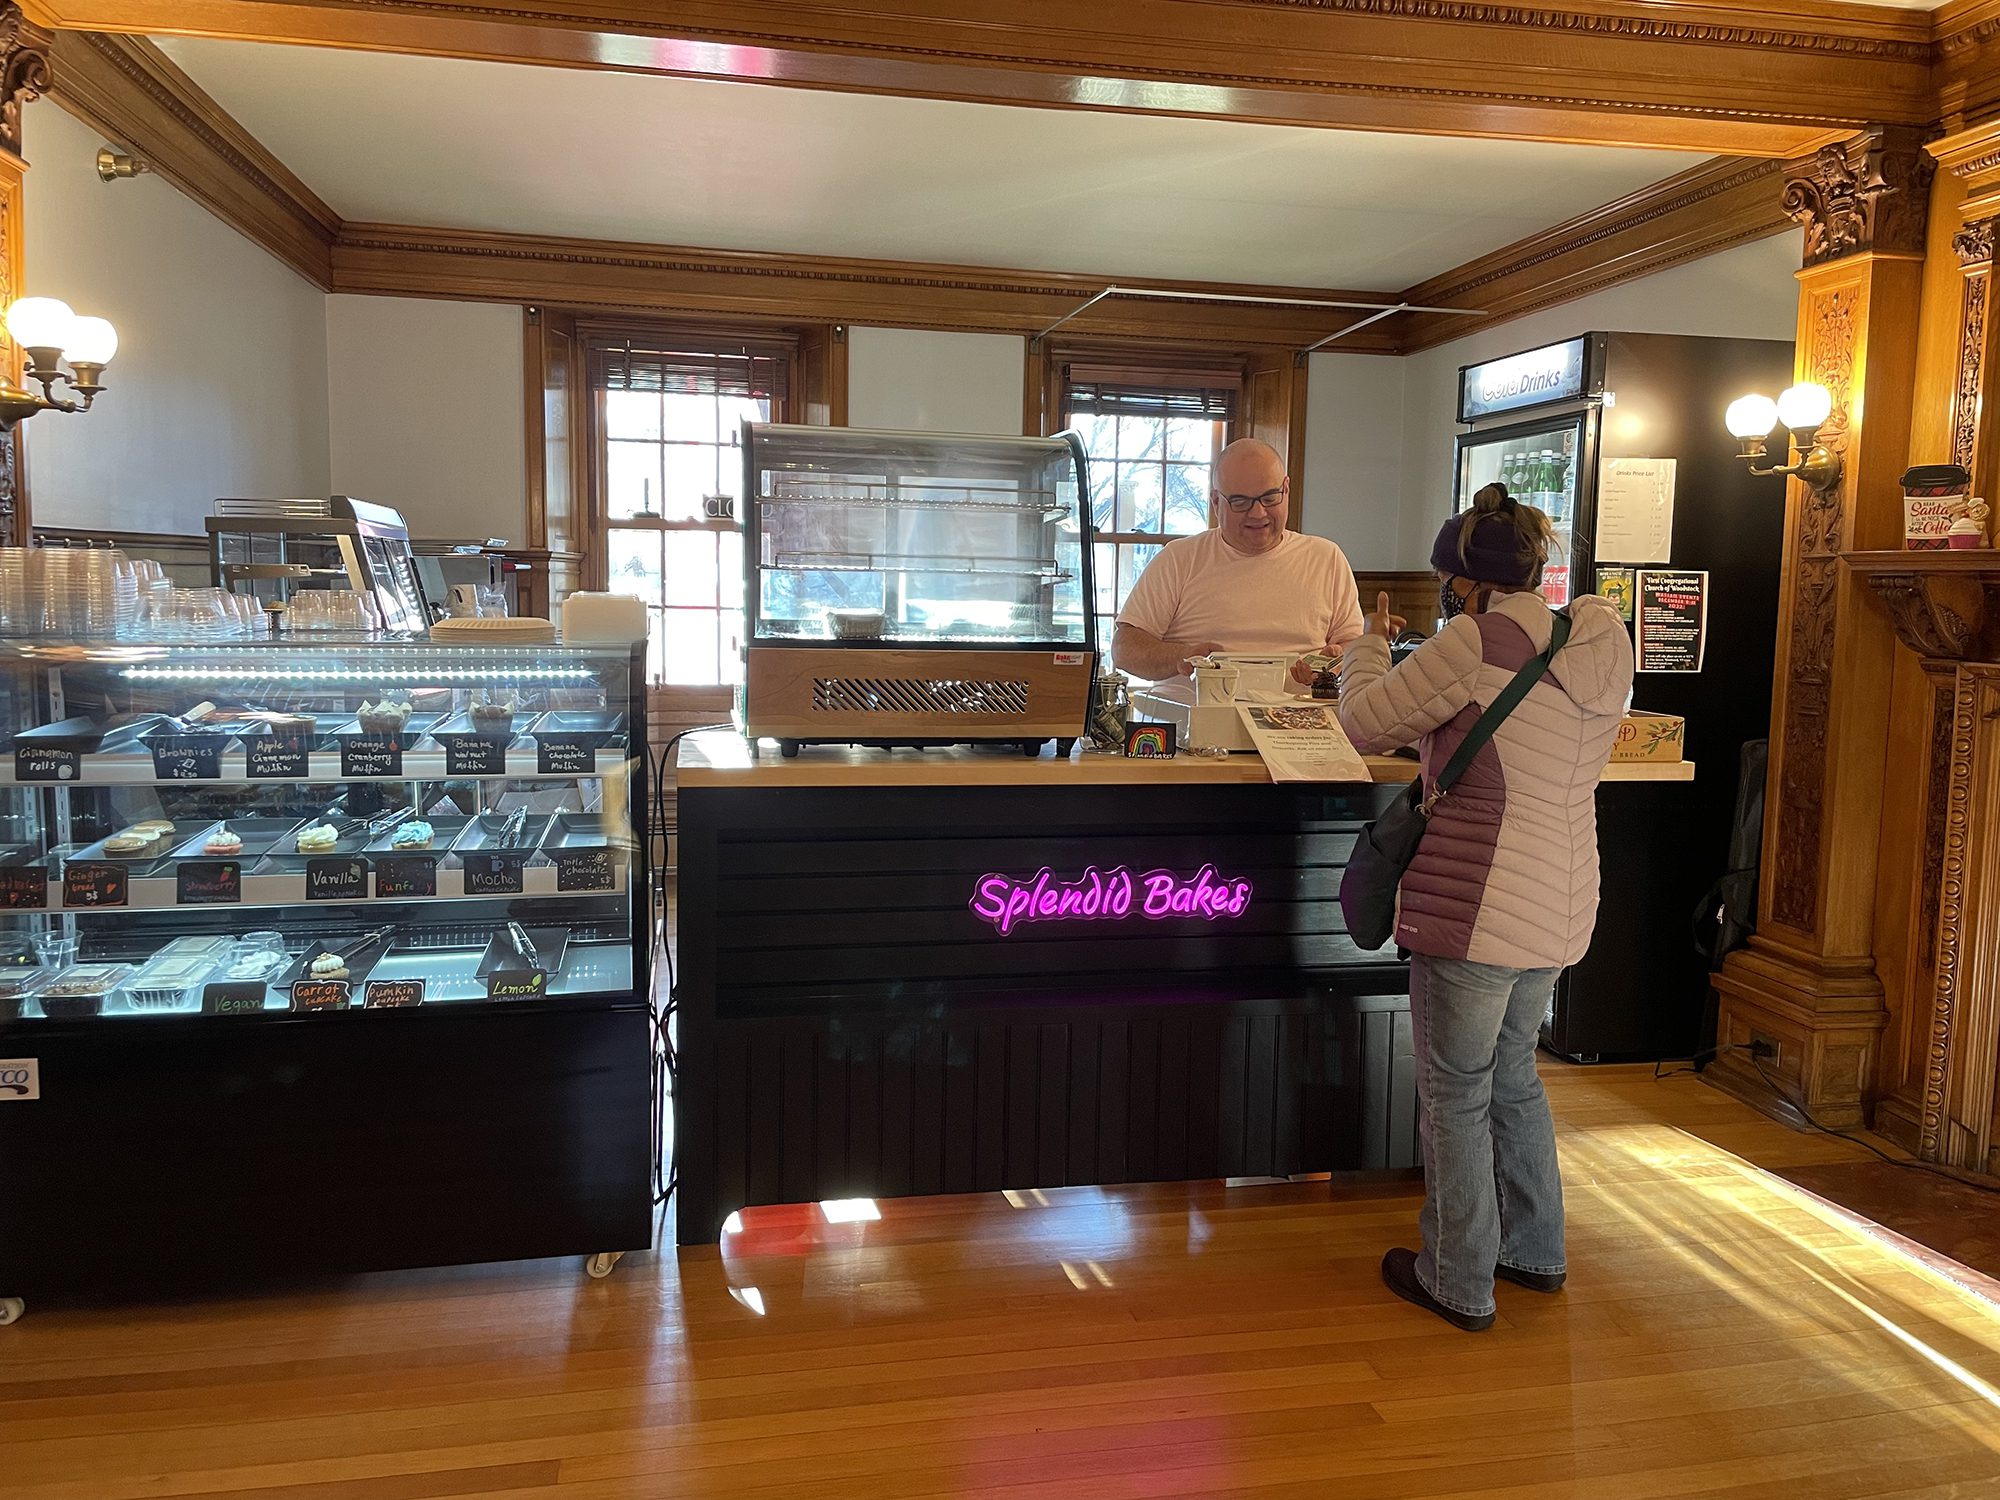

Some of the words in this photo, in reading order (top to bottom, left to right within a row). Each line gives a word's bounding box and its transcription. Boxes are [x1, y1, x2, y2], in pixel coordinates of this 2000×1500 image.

[1519, 369, 1561, 395] Drinks
[1911, 501, 1949, 517] Santa
[1647, 577, 1660, 585] First
[1660, 577, 1699, 586] Congregational
[1644, 584, 1664, 592] Church
[1664, 584, 1670, 593] of
[1670, 584, 1700, 593] Woodstock
[256, 740, 285, 753] Apple
[350, 740, 386, 752] Orange
[454, 738, 494, 749] Banana
[20, 747, 74, 760] Cinnamon
[158, 746, 214, 759] Brownies
[347, 752, 393, 765] Cranberry
[30, 761, 56, 771] rolls
[256, 764, 292, 774] Muffin
[351, 764, 382, 775] Muffin
[455, 760, 487, 771] Muffin
[551, 761, 580, 771] Muffin
[68, 870, 108, 883] Ginger
[312, 870, 359, 886] Vanilla
[472, 871, 517, 886] Mocha
[973, 870, 1132, 932] Splendid
[1142, 868, 1250, 916] Bakes
[296, 983, 340, 997] Carrot
[369, 986, 414, 998] Pumkin
[492, 980, 538, 996] Lemon
[214, 994, 264, 1014] Vegan
